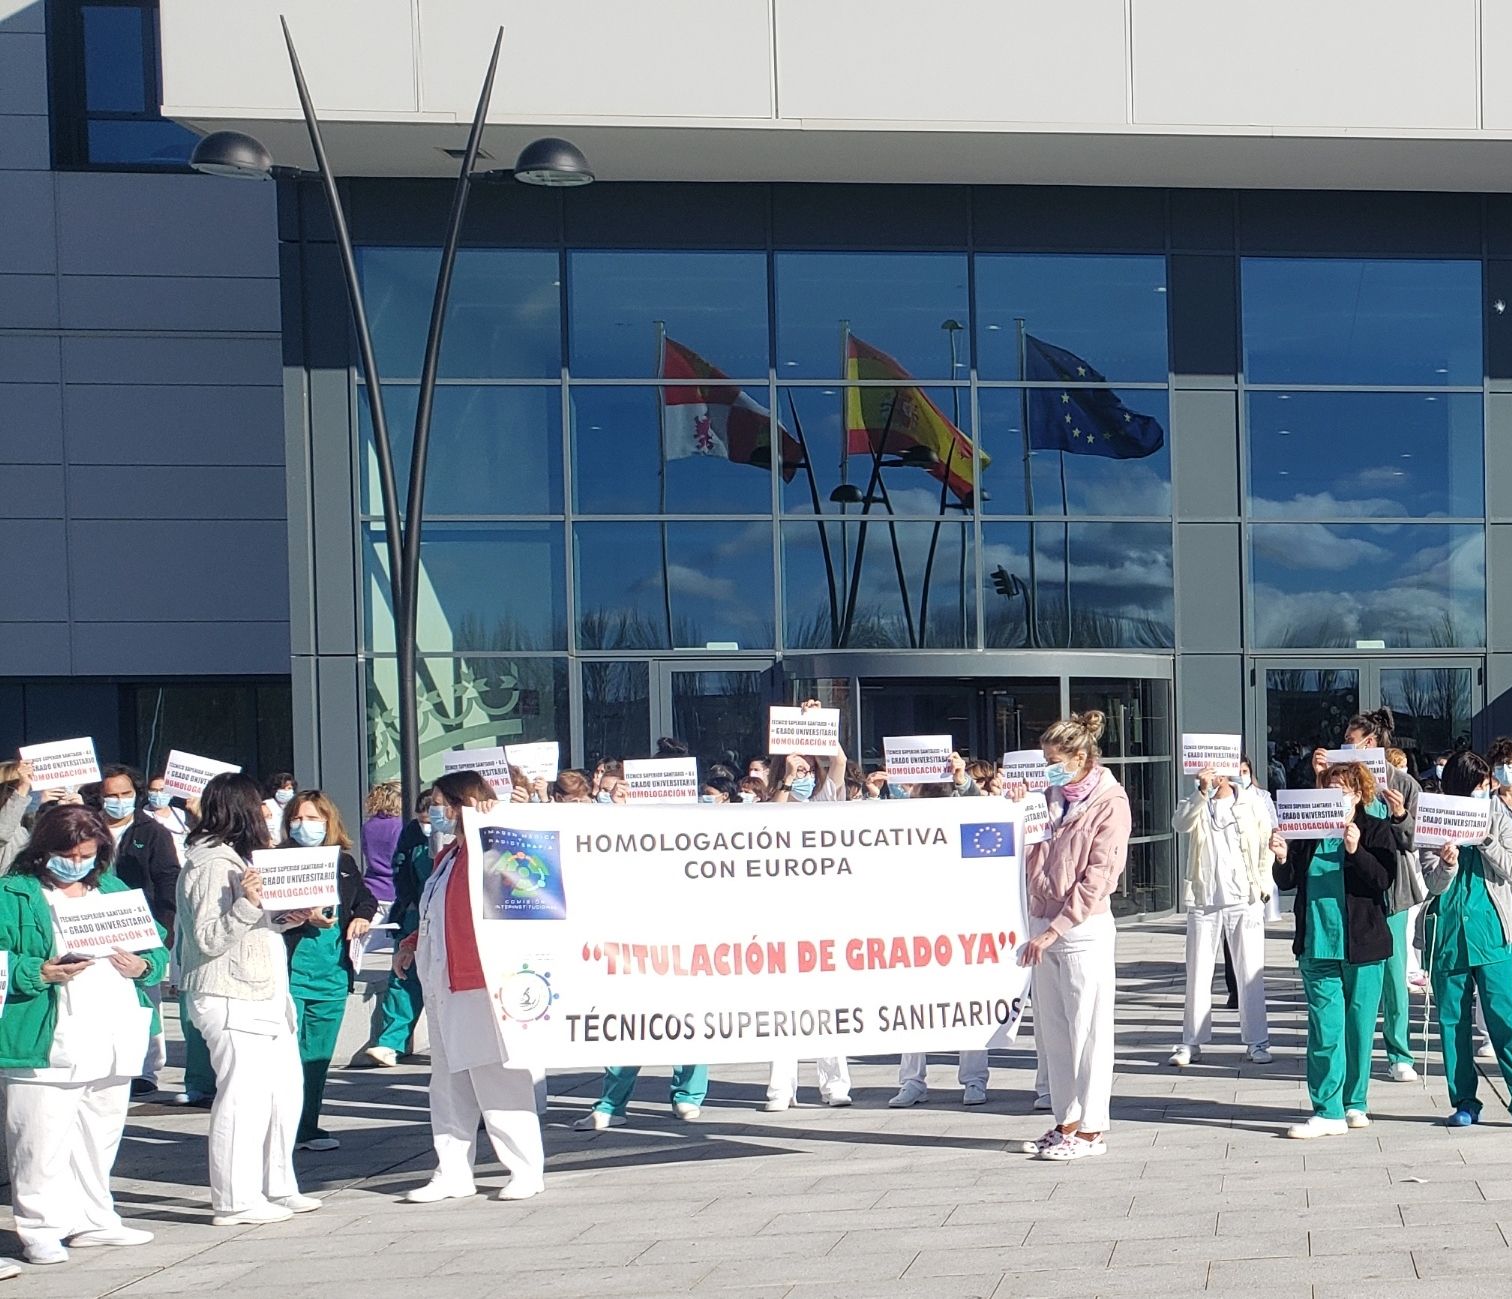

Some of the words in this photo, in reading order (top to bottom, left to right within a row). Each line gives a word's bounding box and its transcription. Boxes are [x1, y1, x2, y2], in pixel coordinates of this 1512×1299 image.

[53, 757, 94, 769] UNIVERSITARIO
[171, 771, 189, 780] GRADO
[1301, 810, 1344, 819] UNIVERSITARIO
[1279, 821, 1334, 831] HOMOLOGACIÓN
[1423, 816, 1442, 824] GRADO
[1444, 818, 1486, 827] UNIVERSITARIO
[1416, 826, 1474, 838] HOMOLOGACIÓN
[575, 826, 791, 853] HOMOLOGACIÓN
[802, 827, 948, 850] EDUCATIVA
[684, 860, 736, 880] CON
[746, 857, 852, 877] EUROPA
[263, 876, 284, 885] GRADO
[287, 872, 335, 883] UNIVERSITARIO
[69, 923, 94, 934] GRADO
[95, 915, 152, 931] UNIVERSITARIO
[67, 930, 143, 949] HOMOLOGACIÓN
[144, 928, 155, 936] YA
[798, 939, 836, 973] DE
[846, 933, 952, 970] GRADO
[565, 1005, 695, 1042] TÉCNICOS
[704, 1006, 864, 1039] SUPERIORES
[879, 997, 1024, 1033] SANITARIOS
